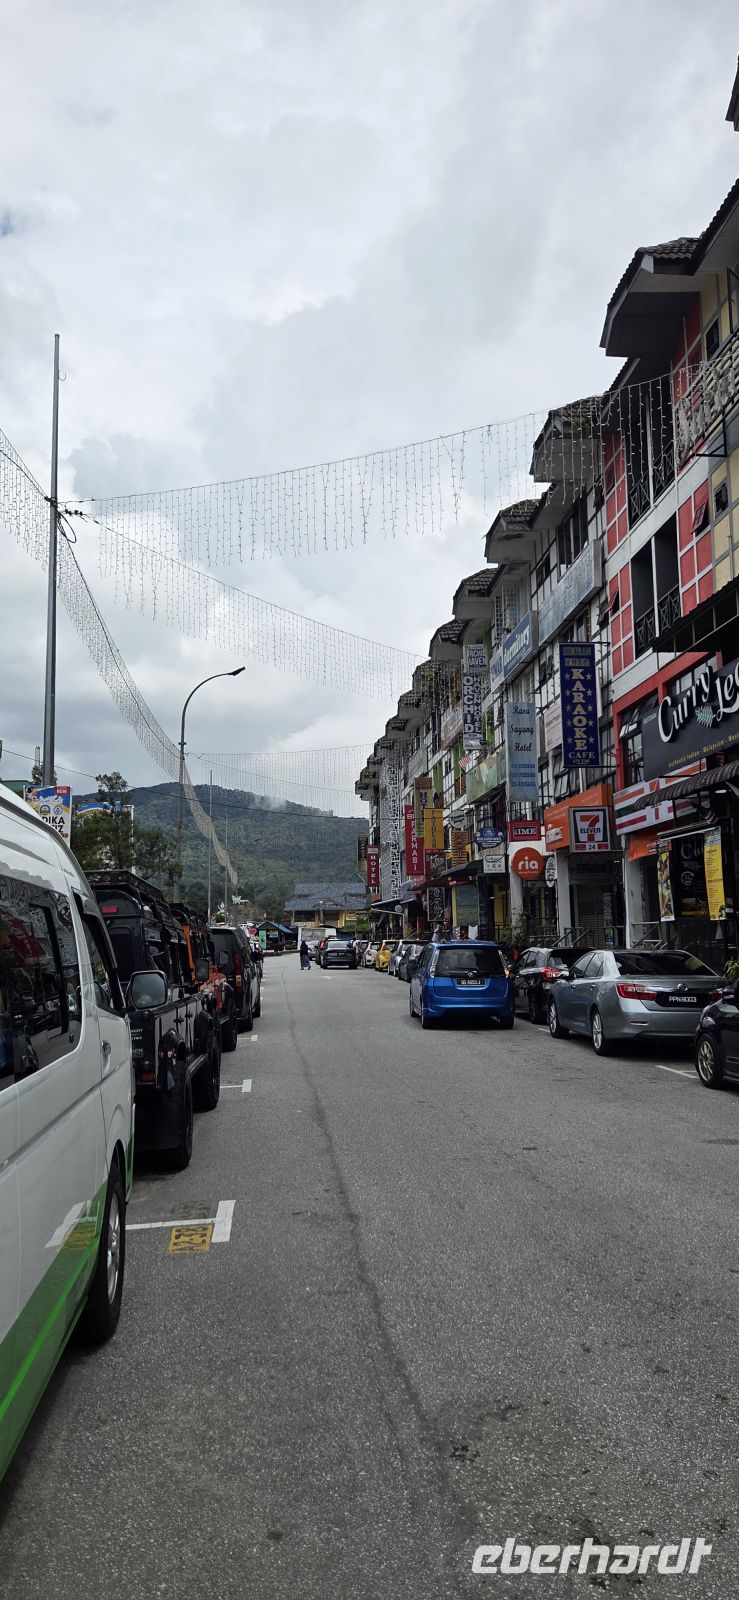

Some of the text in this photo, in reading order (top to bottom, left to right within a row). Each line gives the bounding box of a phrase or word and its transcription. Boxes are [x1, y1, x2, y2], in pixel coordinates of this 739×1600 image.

[463, 676, 474, 733] ORCHID
[512, 705, 530, 714] Rasa
[571, 668, 588, 750] KARAOKE
[658, 666, 711, 742] Curry
[510, 724, 535, 735] Sayang
[513, 742, 532, 752] Hotel
[568, 751, 595, 759] CAFE
[579, 815, 600, 842] 7
[518, 856, 539, 870] ria
